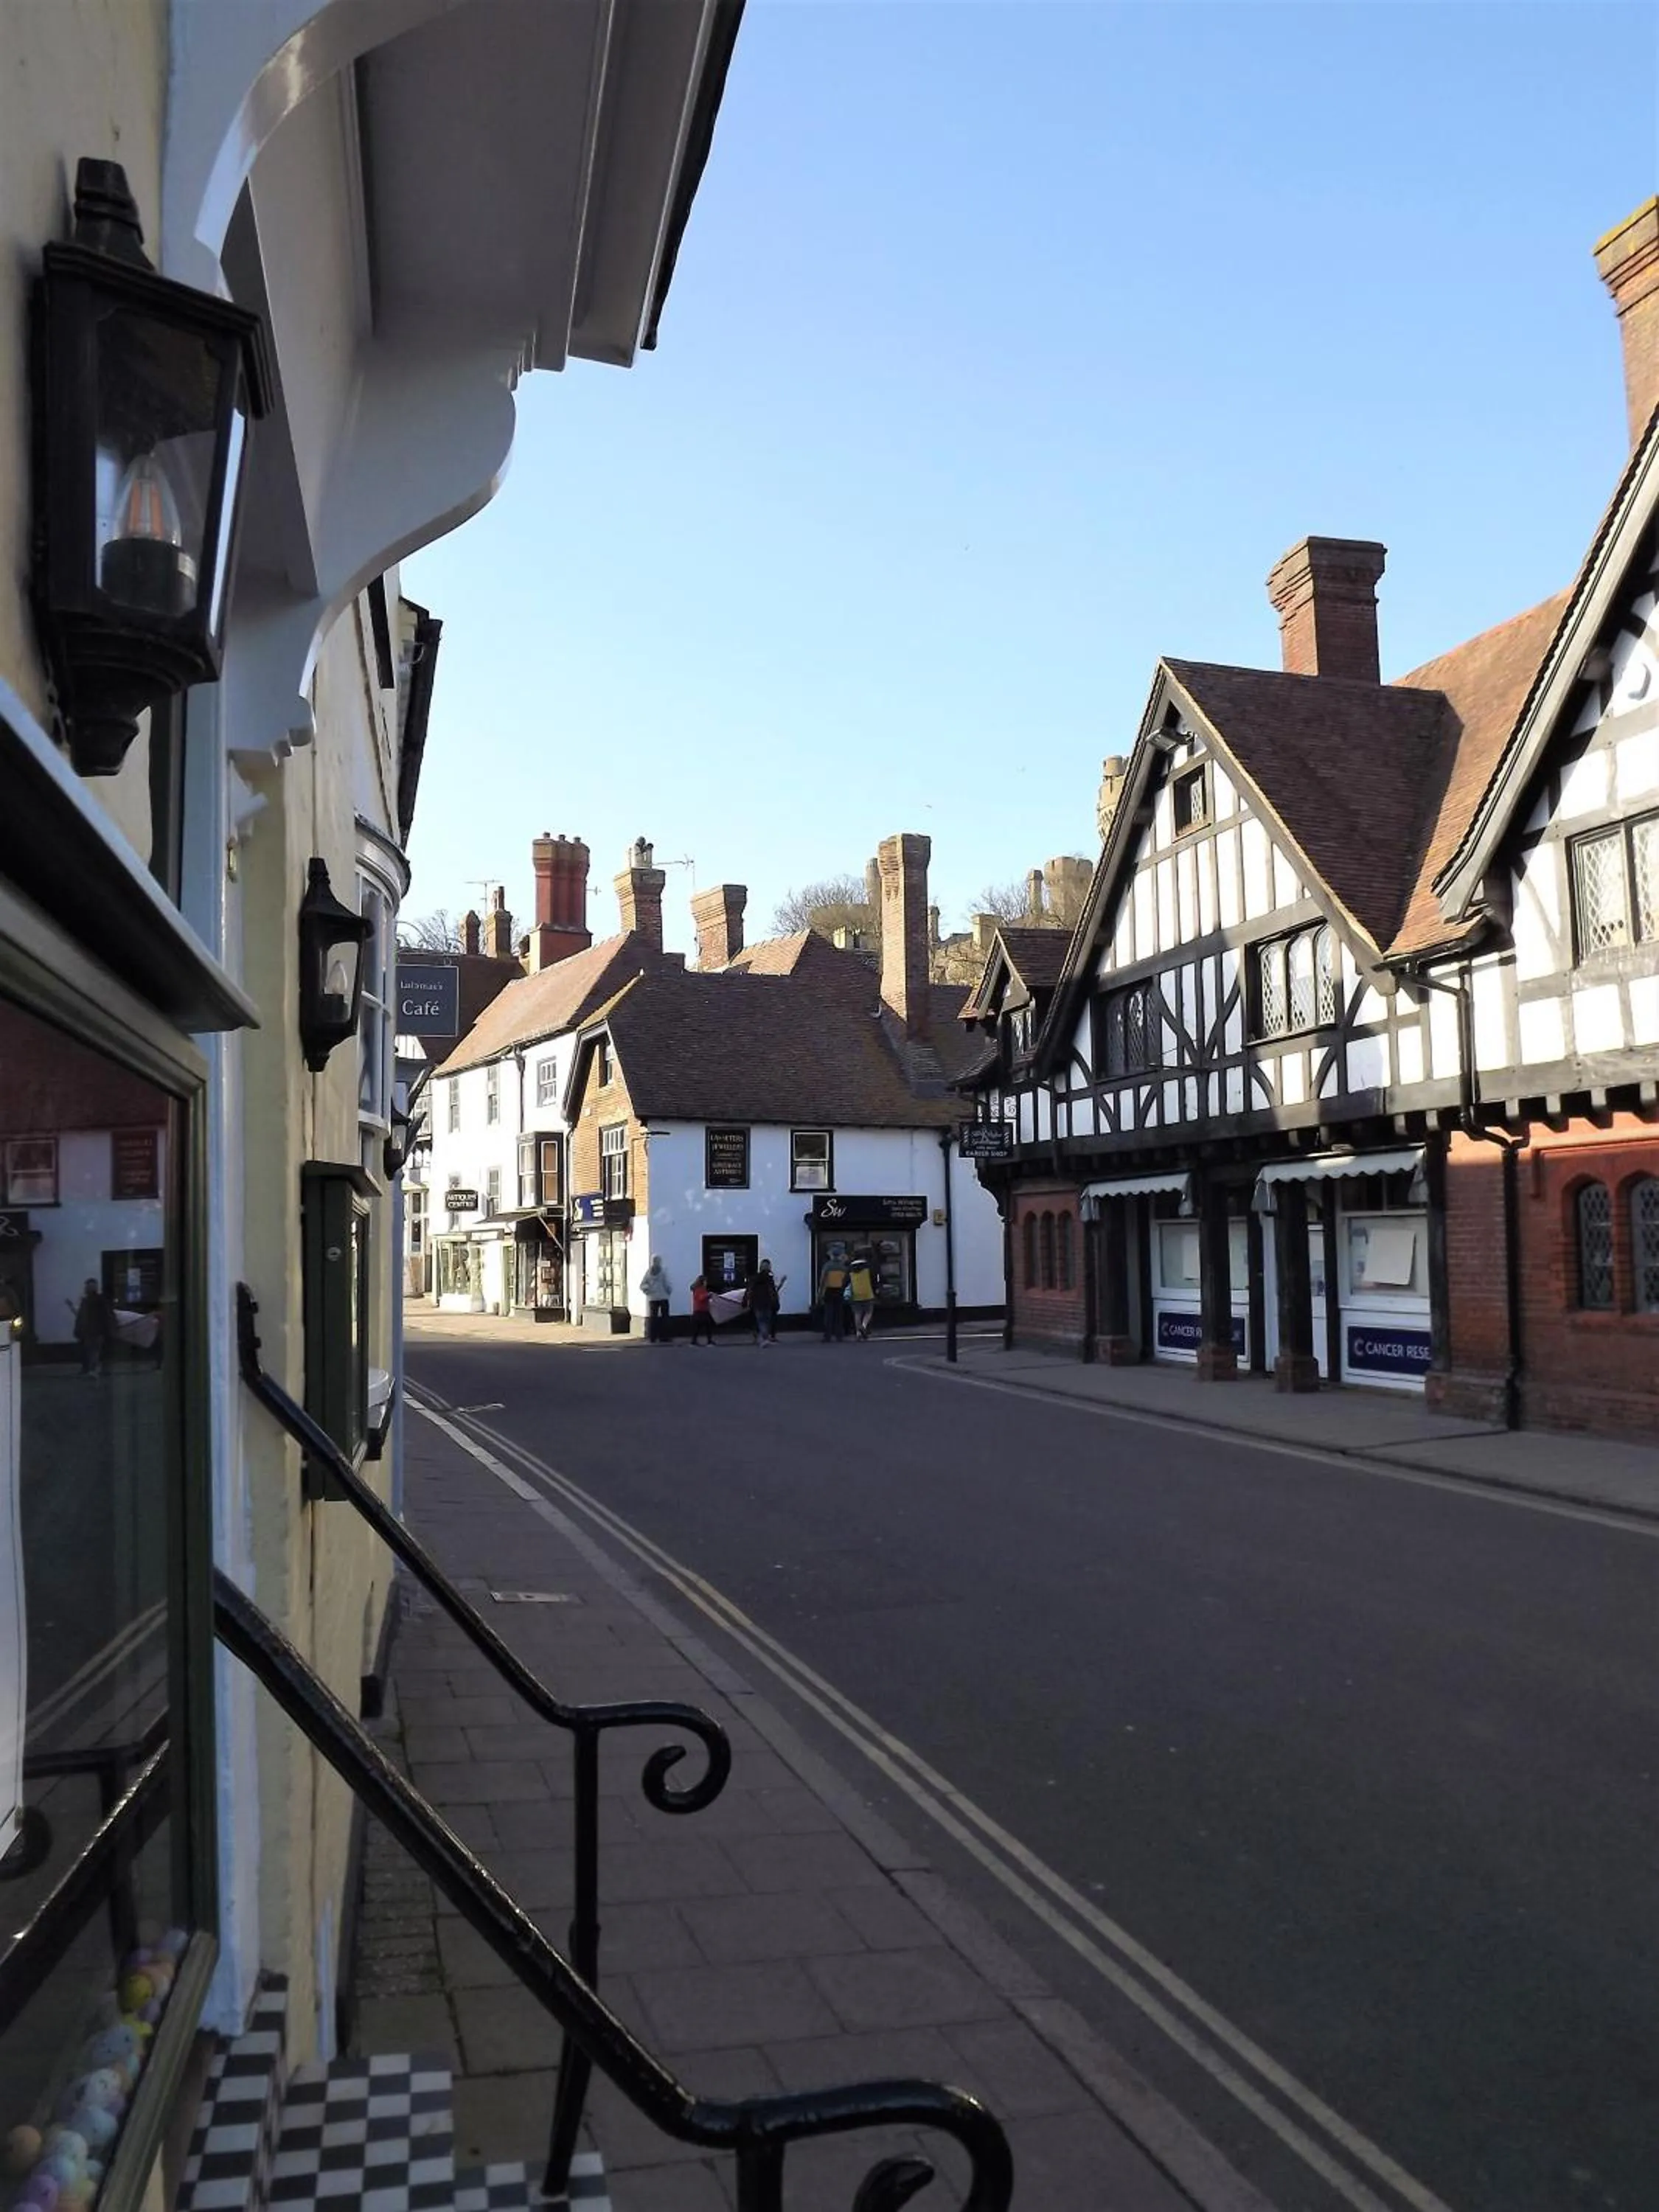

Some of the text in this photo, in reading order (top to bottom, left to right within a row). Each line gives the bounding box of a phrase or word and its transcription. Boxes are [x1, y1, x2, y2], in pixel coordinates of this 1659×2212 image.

[402, 999, 440, 1016] Café
[1169, 1324, 1195, 1338] CANCER
[1365, 1341, 1405, 1357] CANCER
